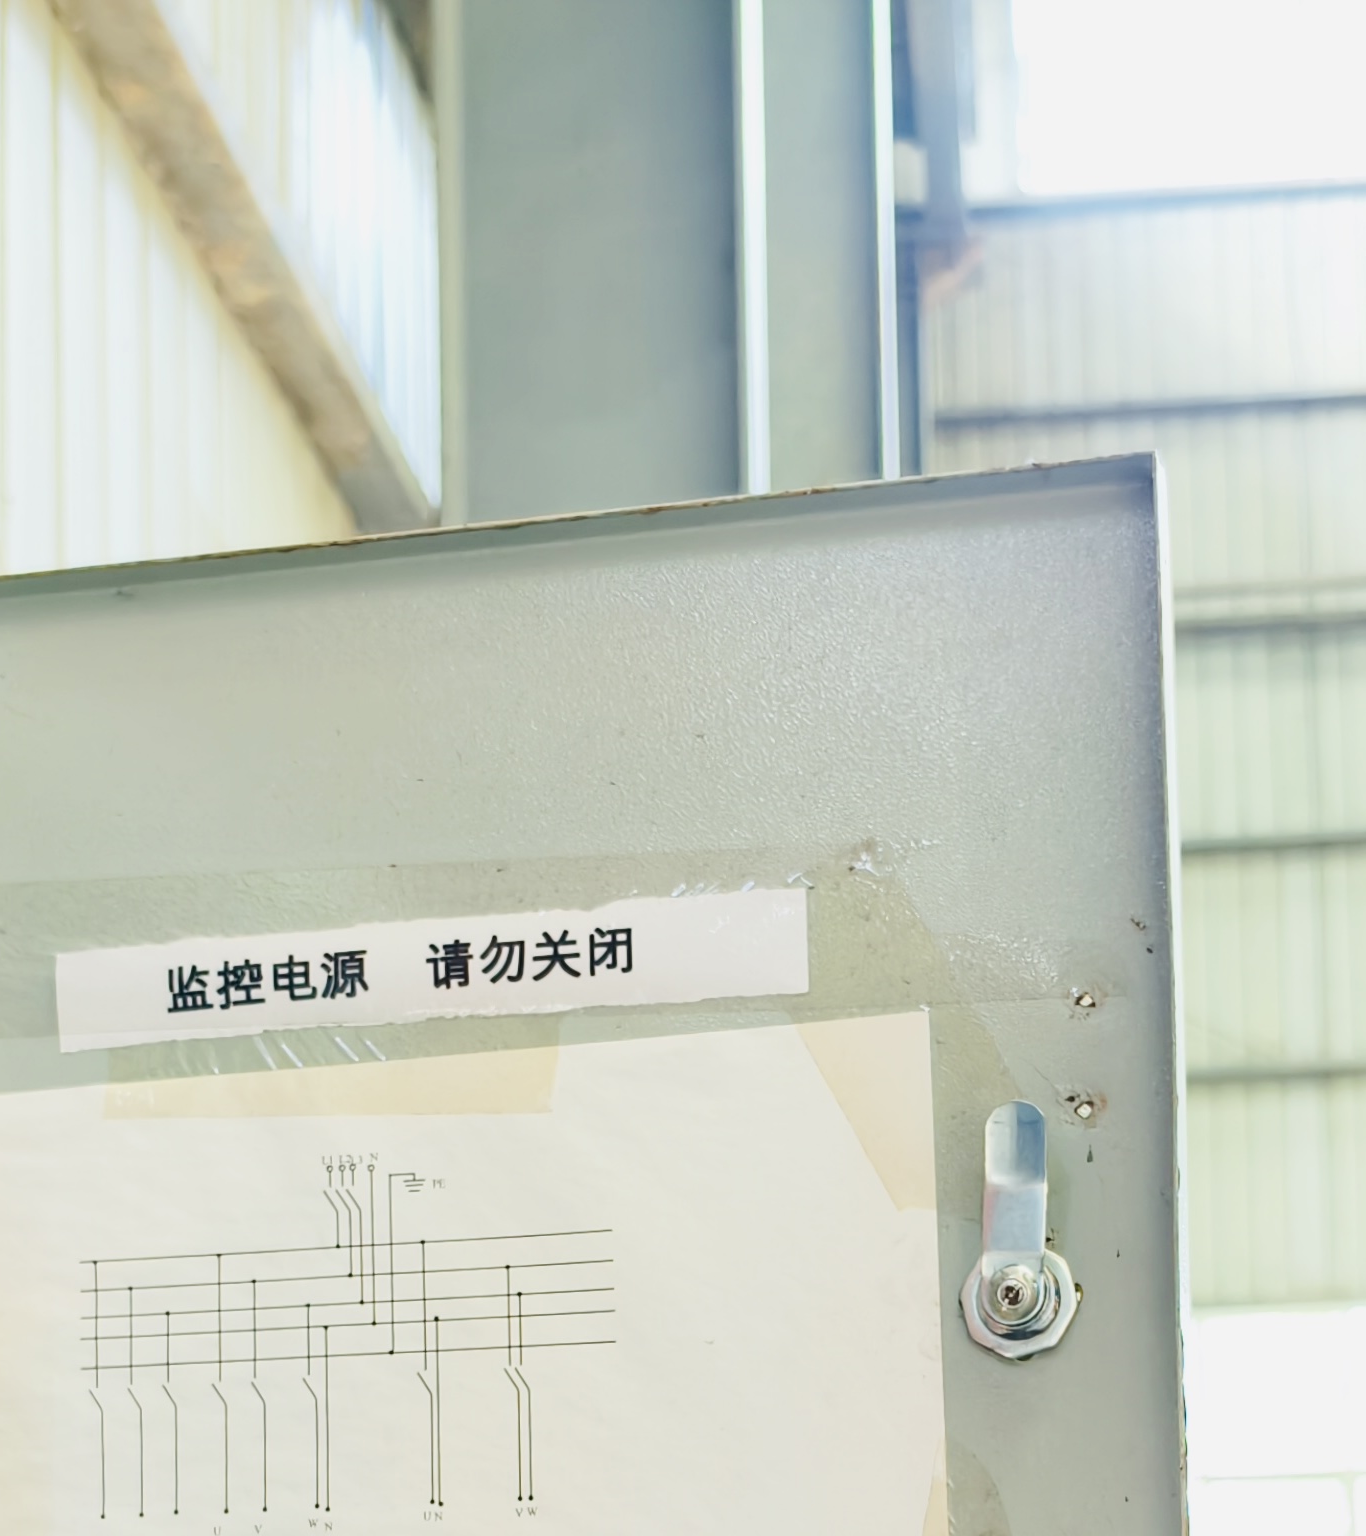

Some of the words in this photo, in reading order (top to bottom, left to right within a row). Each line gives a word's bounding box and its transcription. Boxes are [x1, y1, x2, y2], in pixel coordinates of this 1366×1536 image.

[167, 950, 369, 1013] 监控电源
[426, 926, 634, 989] 请勿关闭
